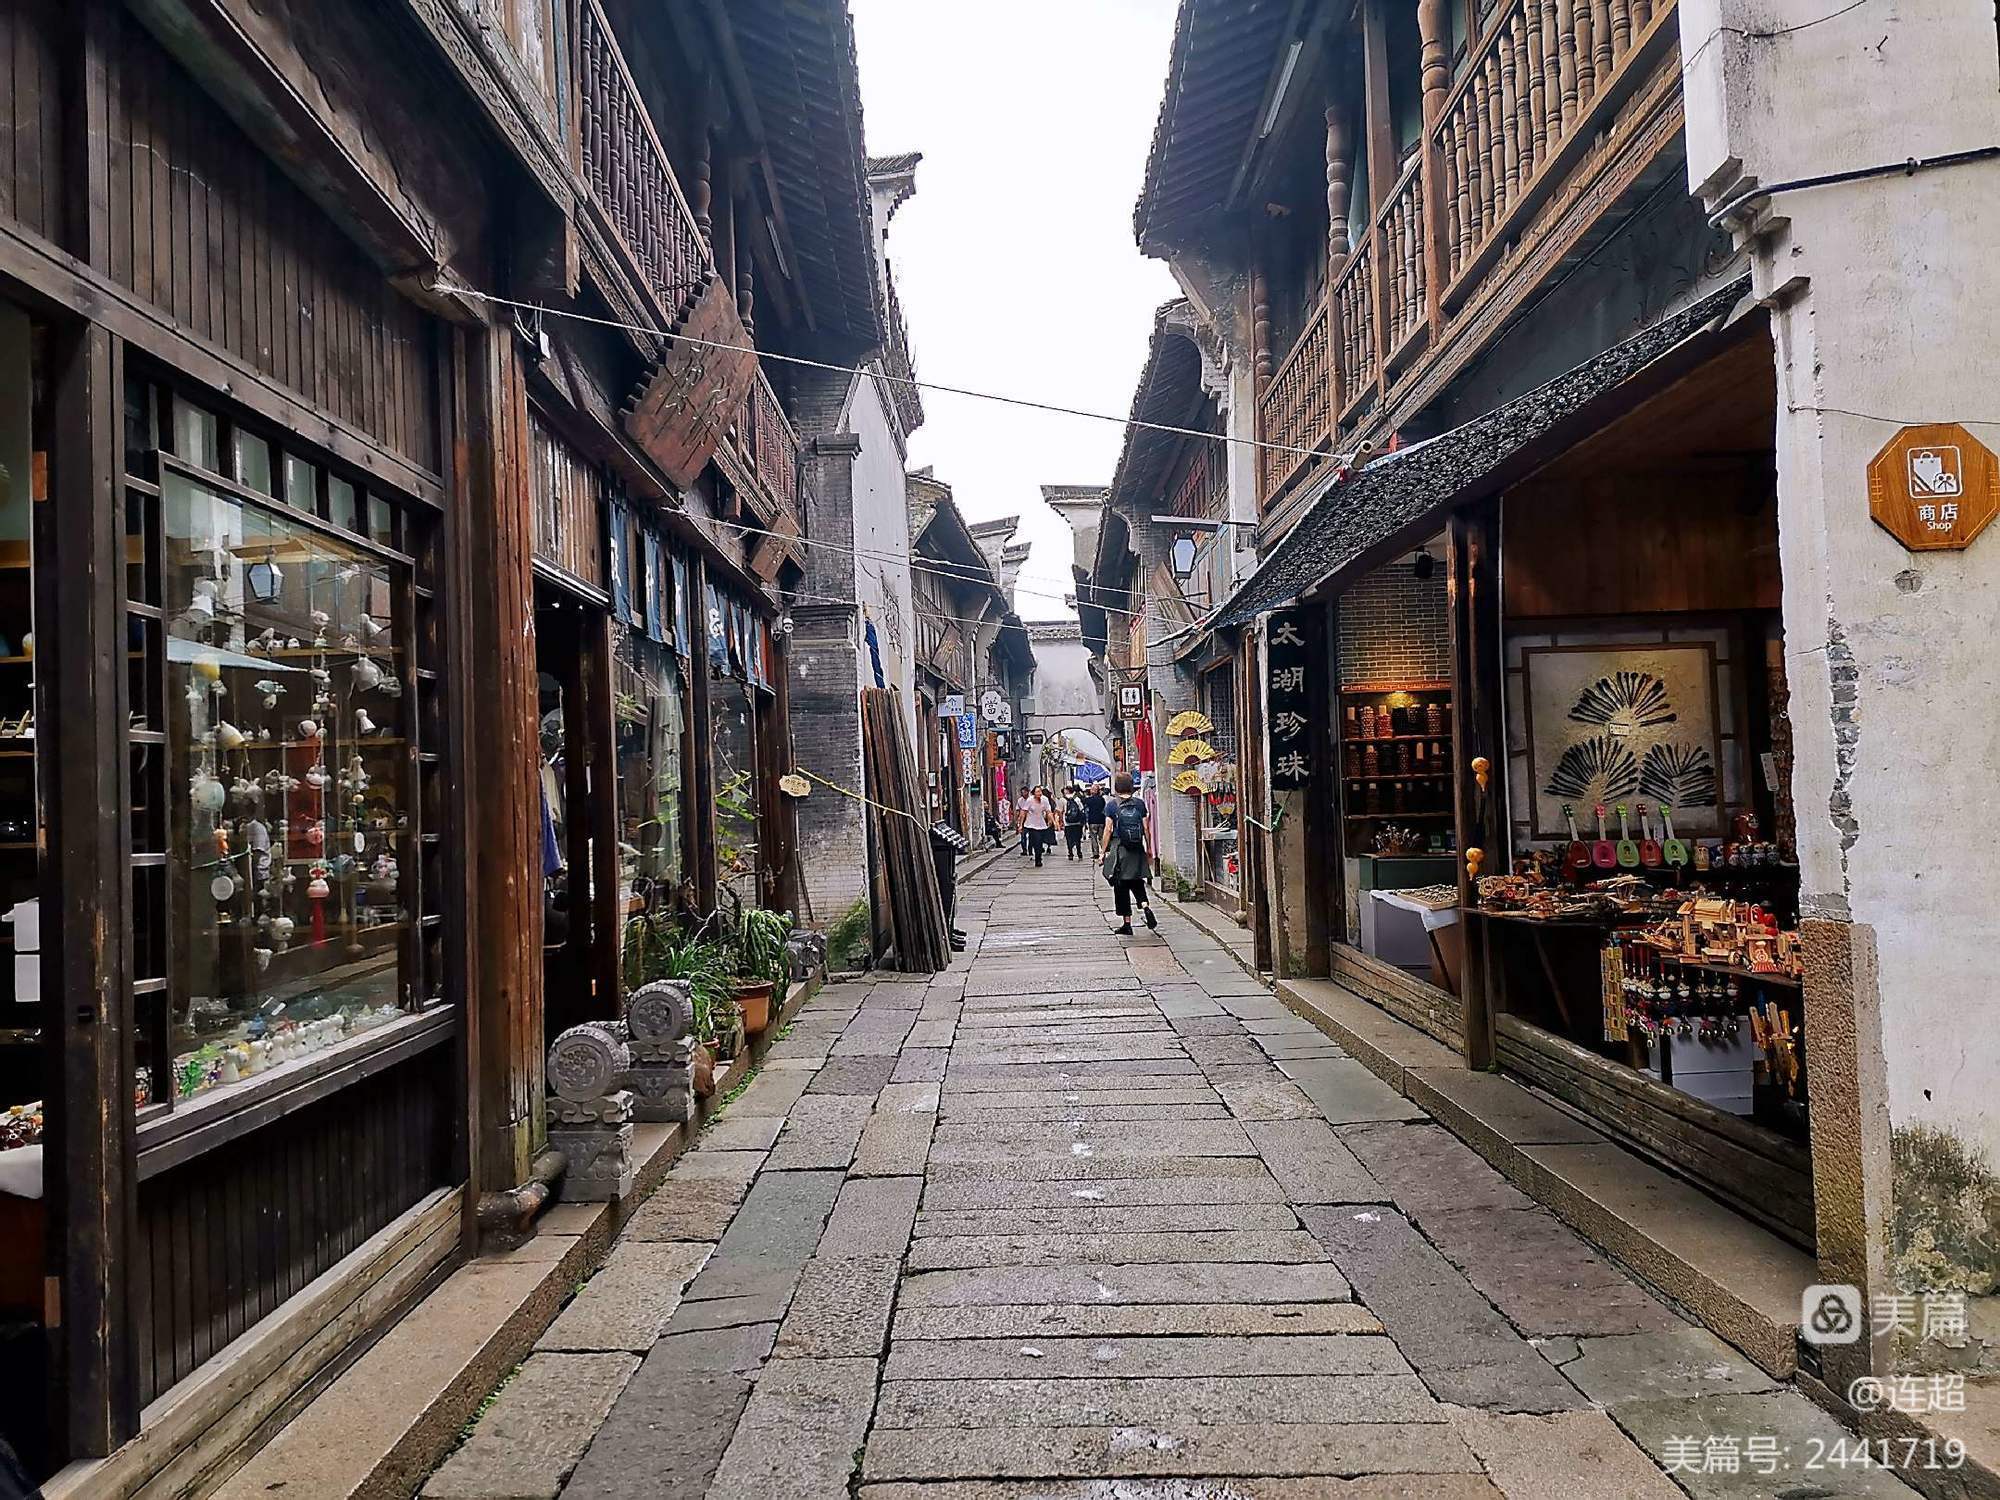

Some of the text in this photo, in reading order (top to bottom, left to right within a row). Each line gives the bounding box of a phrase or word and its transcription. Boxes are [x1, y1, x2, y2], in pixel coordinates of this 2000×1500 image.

[1918, 503, 1958, 521] 商店
[1927, 521, 1952, 532] Shop
[1271, 622, 1310, 781] 太湖珍珠
